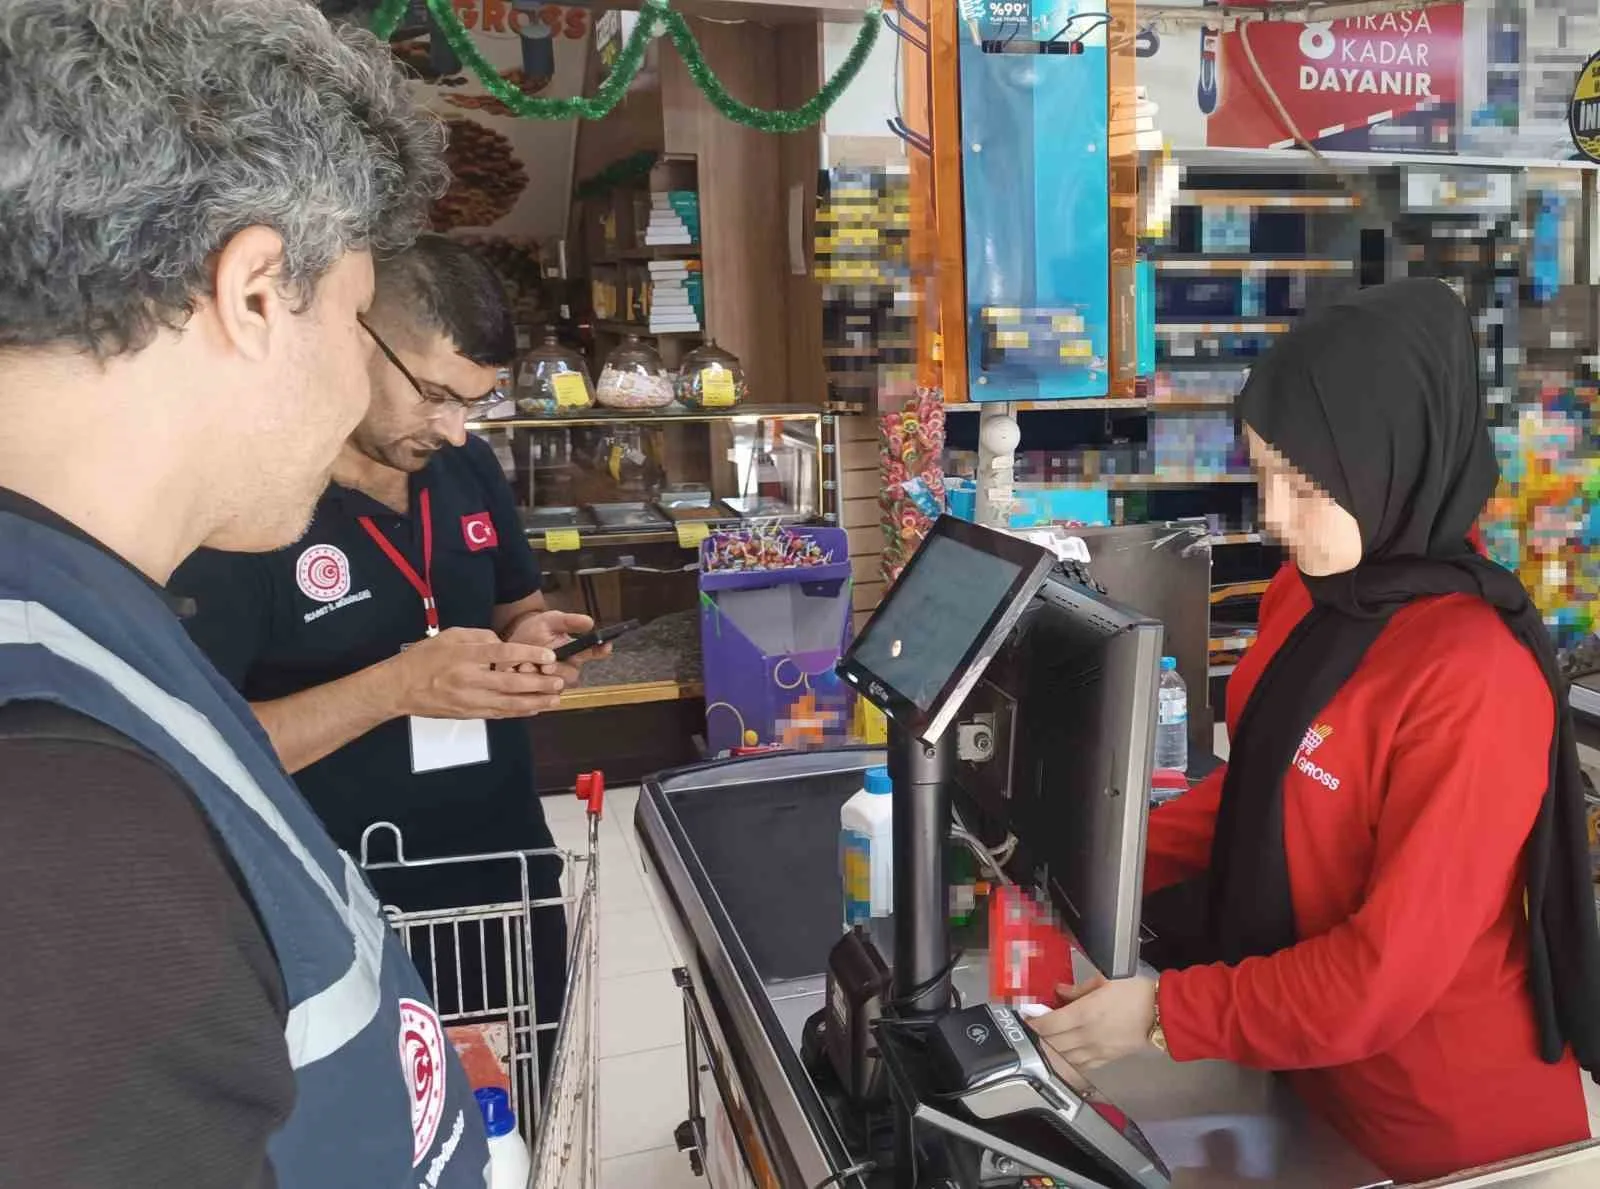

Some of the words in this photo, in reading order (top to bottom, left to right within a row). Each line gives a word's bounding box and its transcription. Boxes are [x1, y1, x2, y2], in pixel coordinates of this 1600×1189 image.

[1341, 38, 1430, 67] KADAR
[1299, 65, 1433, 97] DAYANIR
[1297, 756, 1341, 791] GROSS
